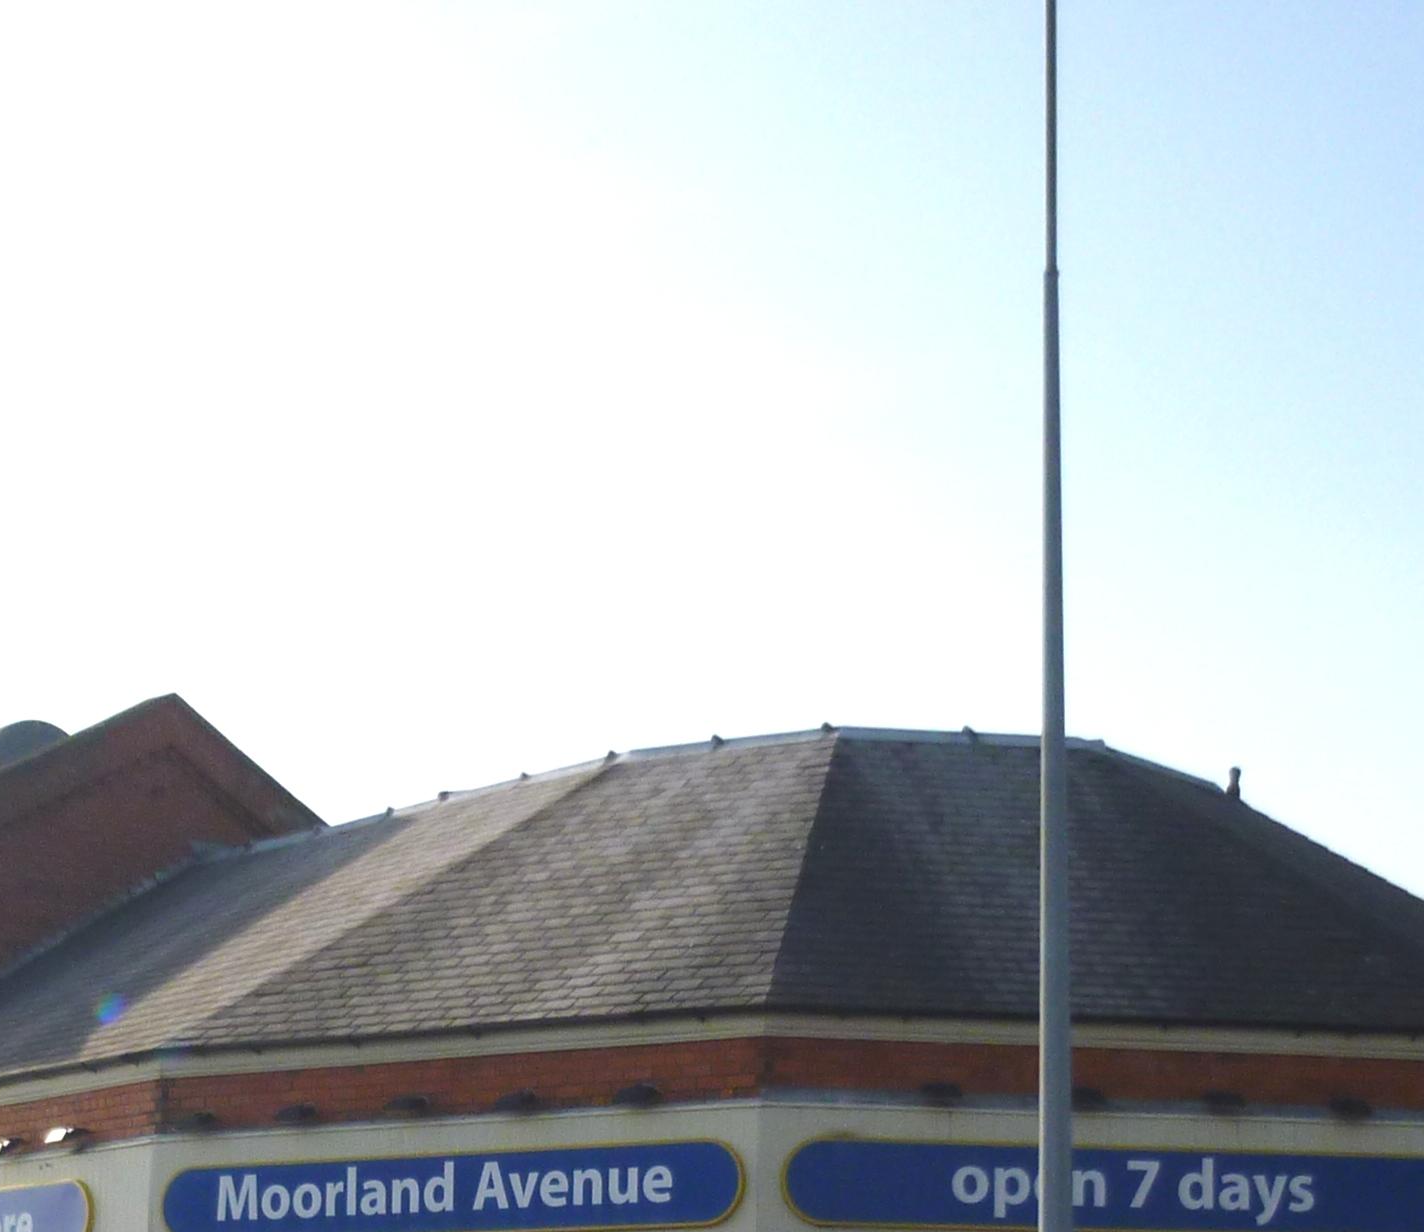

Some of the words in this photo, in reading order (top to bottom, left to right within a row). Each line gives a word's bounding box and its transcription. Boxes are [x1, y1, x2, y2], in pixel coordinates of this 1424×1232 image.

[216, 1161, 455, 1222] Moorland
[473, 1160, 674, 1212] Avenue
[951, 1163, 1107, 1219] opn
[1126, 1159, 1161, 1209] 7
[1177, 1157, 1316, 1227] days
